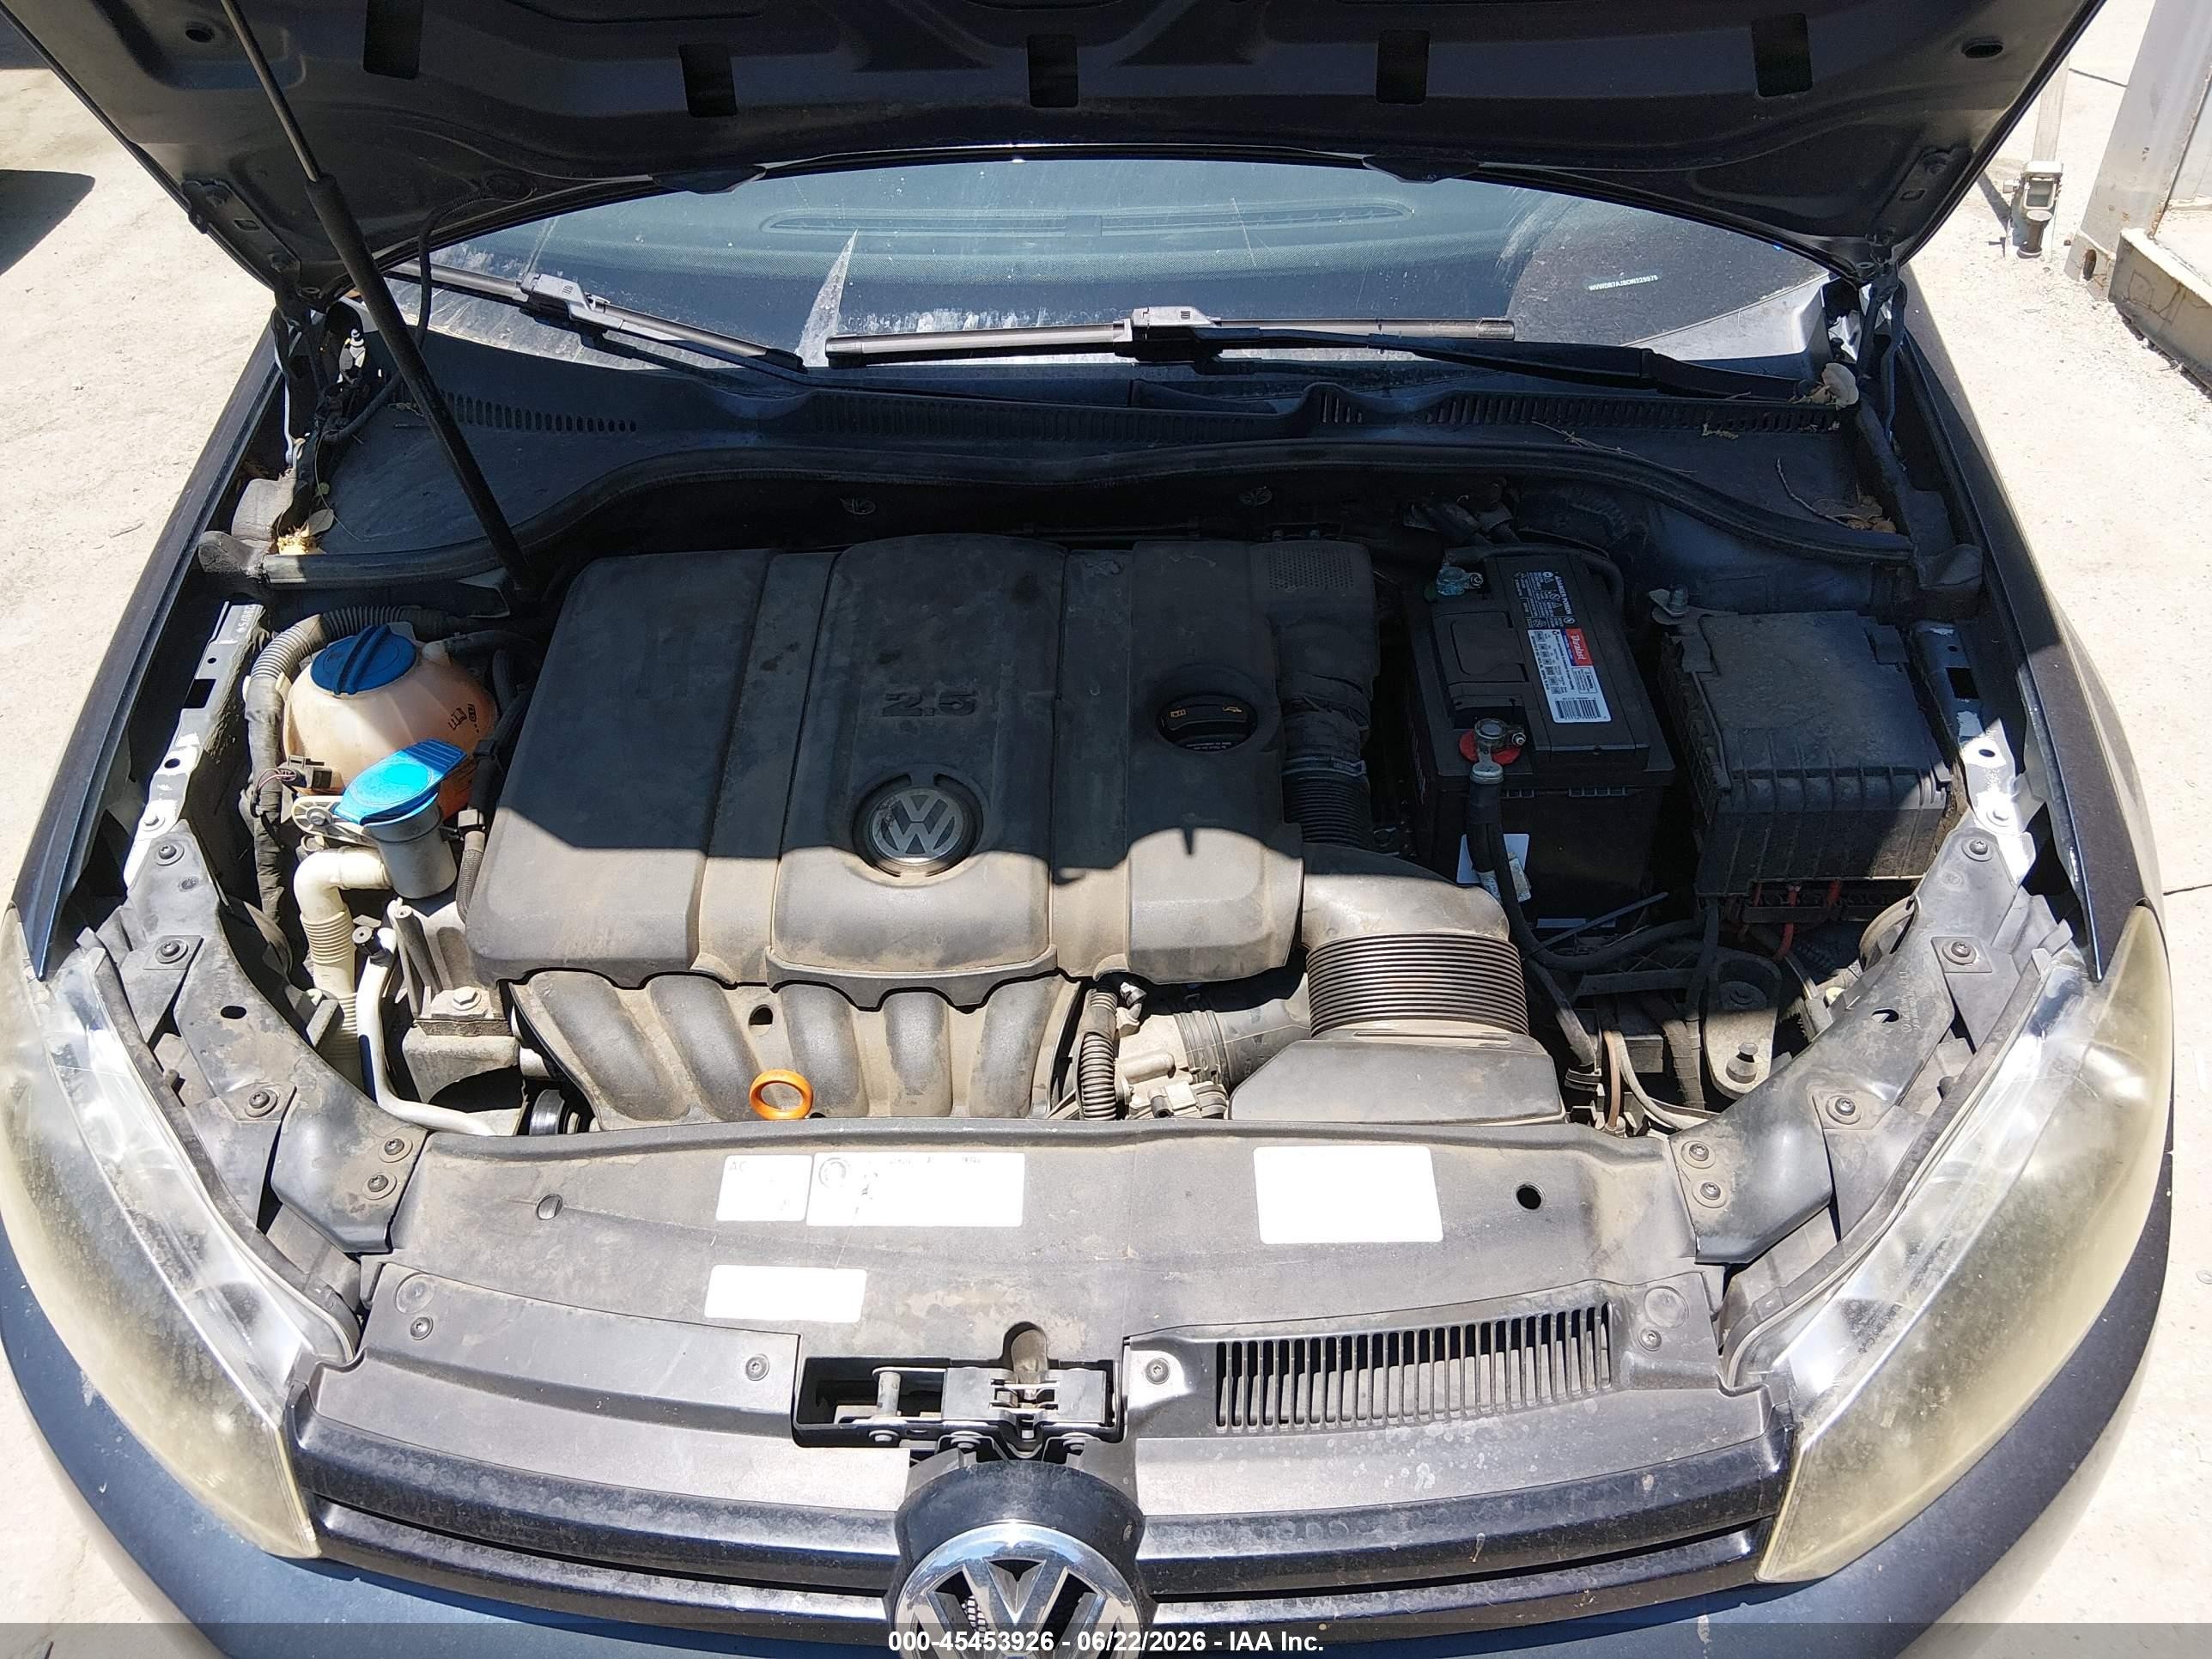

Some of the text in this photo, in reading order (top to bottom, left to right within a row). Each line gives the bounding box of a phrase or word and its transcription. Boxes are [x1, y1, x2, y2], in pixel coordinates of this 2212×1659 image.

[1570, 634, 1587, 660] Duralast
[882, 692, 976, 716] 2.5
[872, 787, 963, 862] VW
